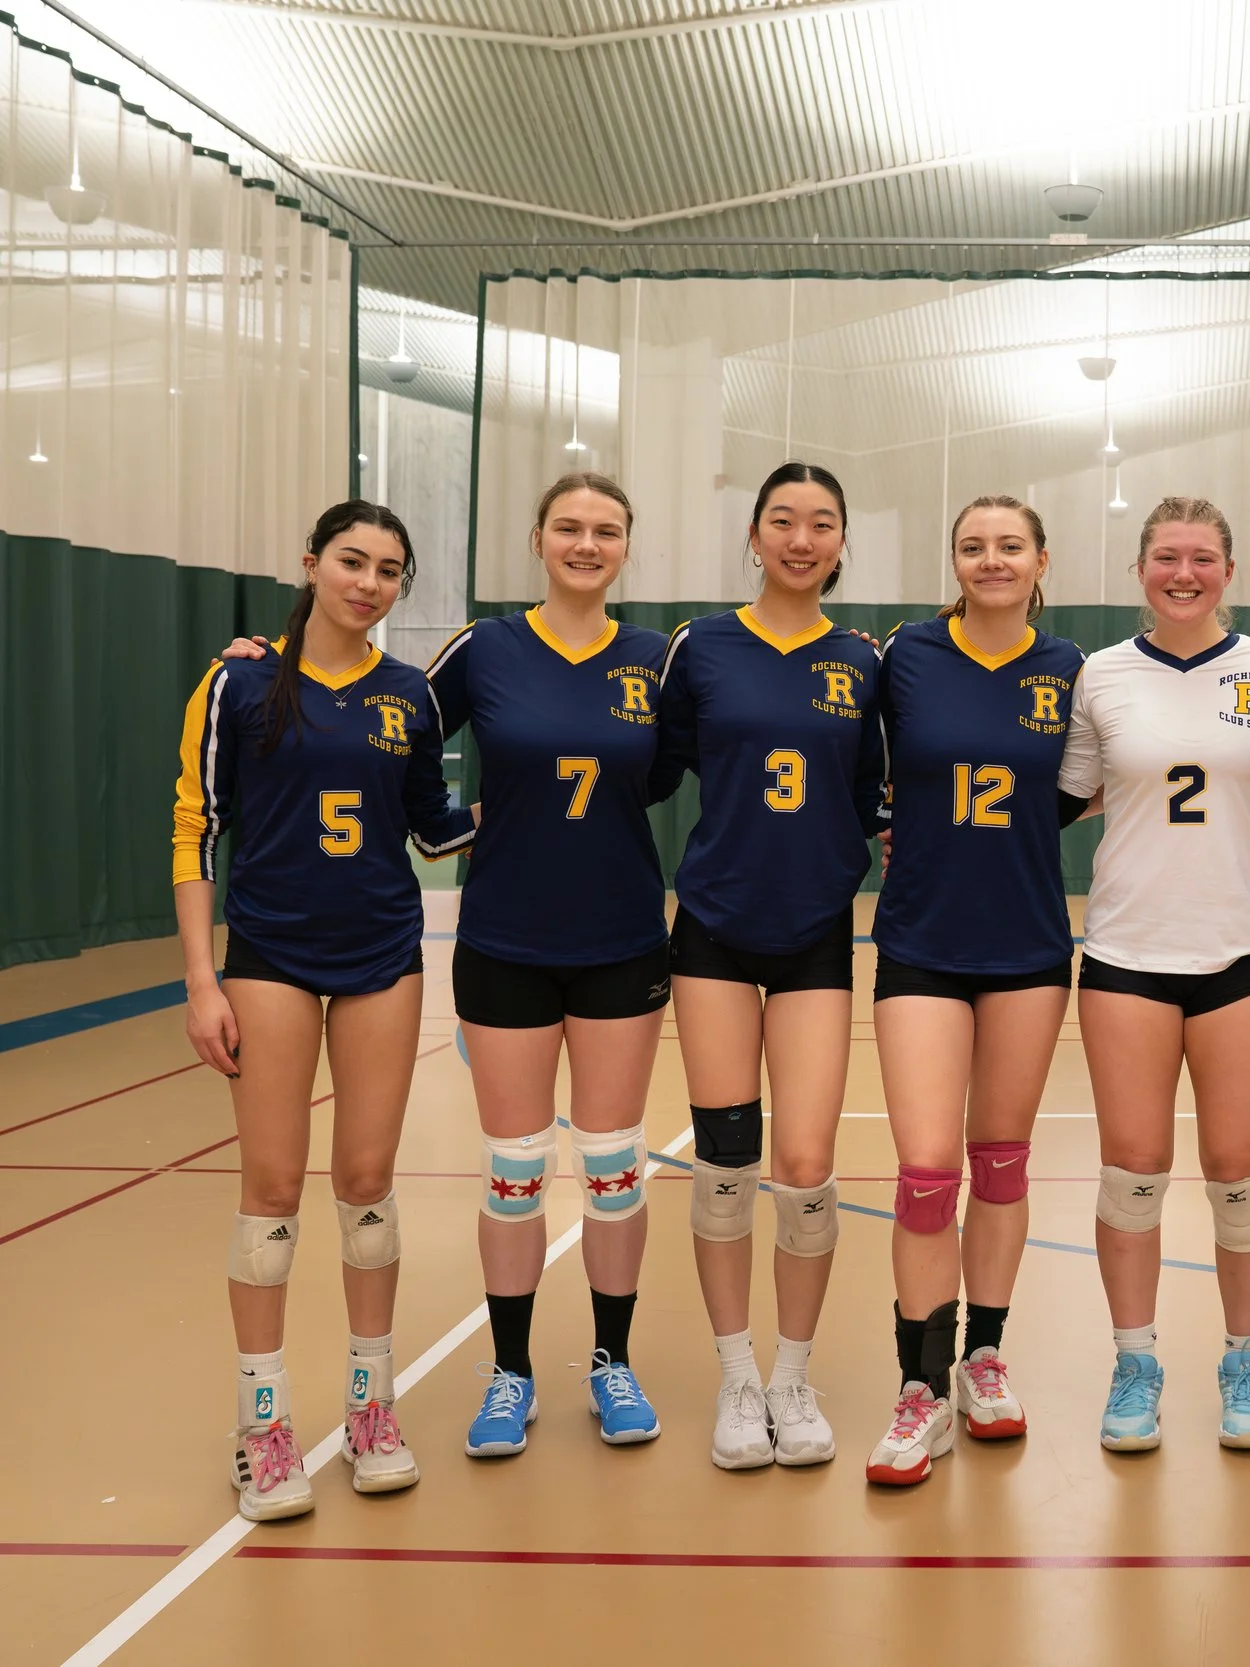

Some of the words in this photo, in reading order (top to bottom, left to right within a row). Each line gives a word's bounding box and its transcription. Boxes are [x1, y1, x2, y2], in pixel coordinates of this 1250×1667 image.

[811, 661, 864, 683] ROCHESTER
[824, 670, 855, 708] R
[620, 676, 651, 713] R
[812, 698, 836, 714] CLUB
[1032, 685, 1060, 722] R
[378, 704, 408, 744] R
[610, 706, 635, 723] CLUB
[1019, 715, 1041, 732] CLUB
[1219, 711, 1244, 726] CLUB
[368, 733, 391, 752] CLUB
[557, 756, 600, 819] 7
[764, 748, 806, 812] 3
[953, 763, 1015, 828] 12
[1165, 762, 1208, 826] 2
[319, 790, 362, 857] 5
